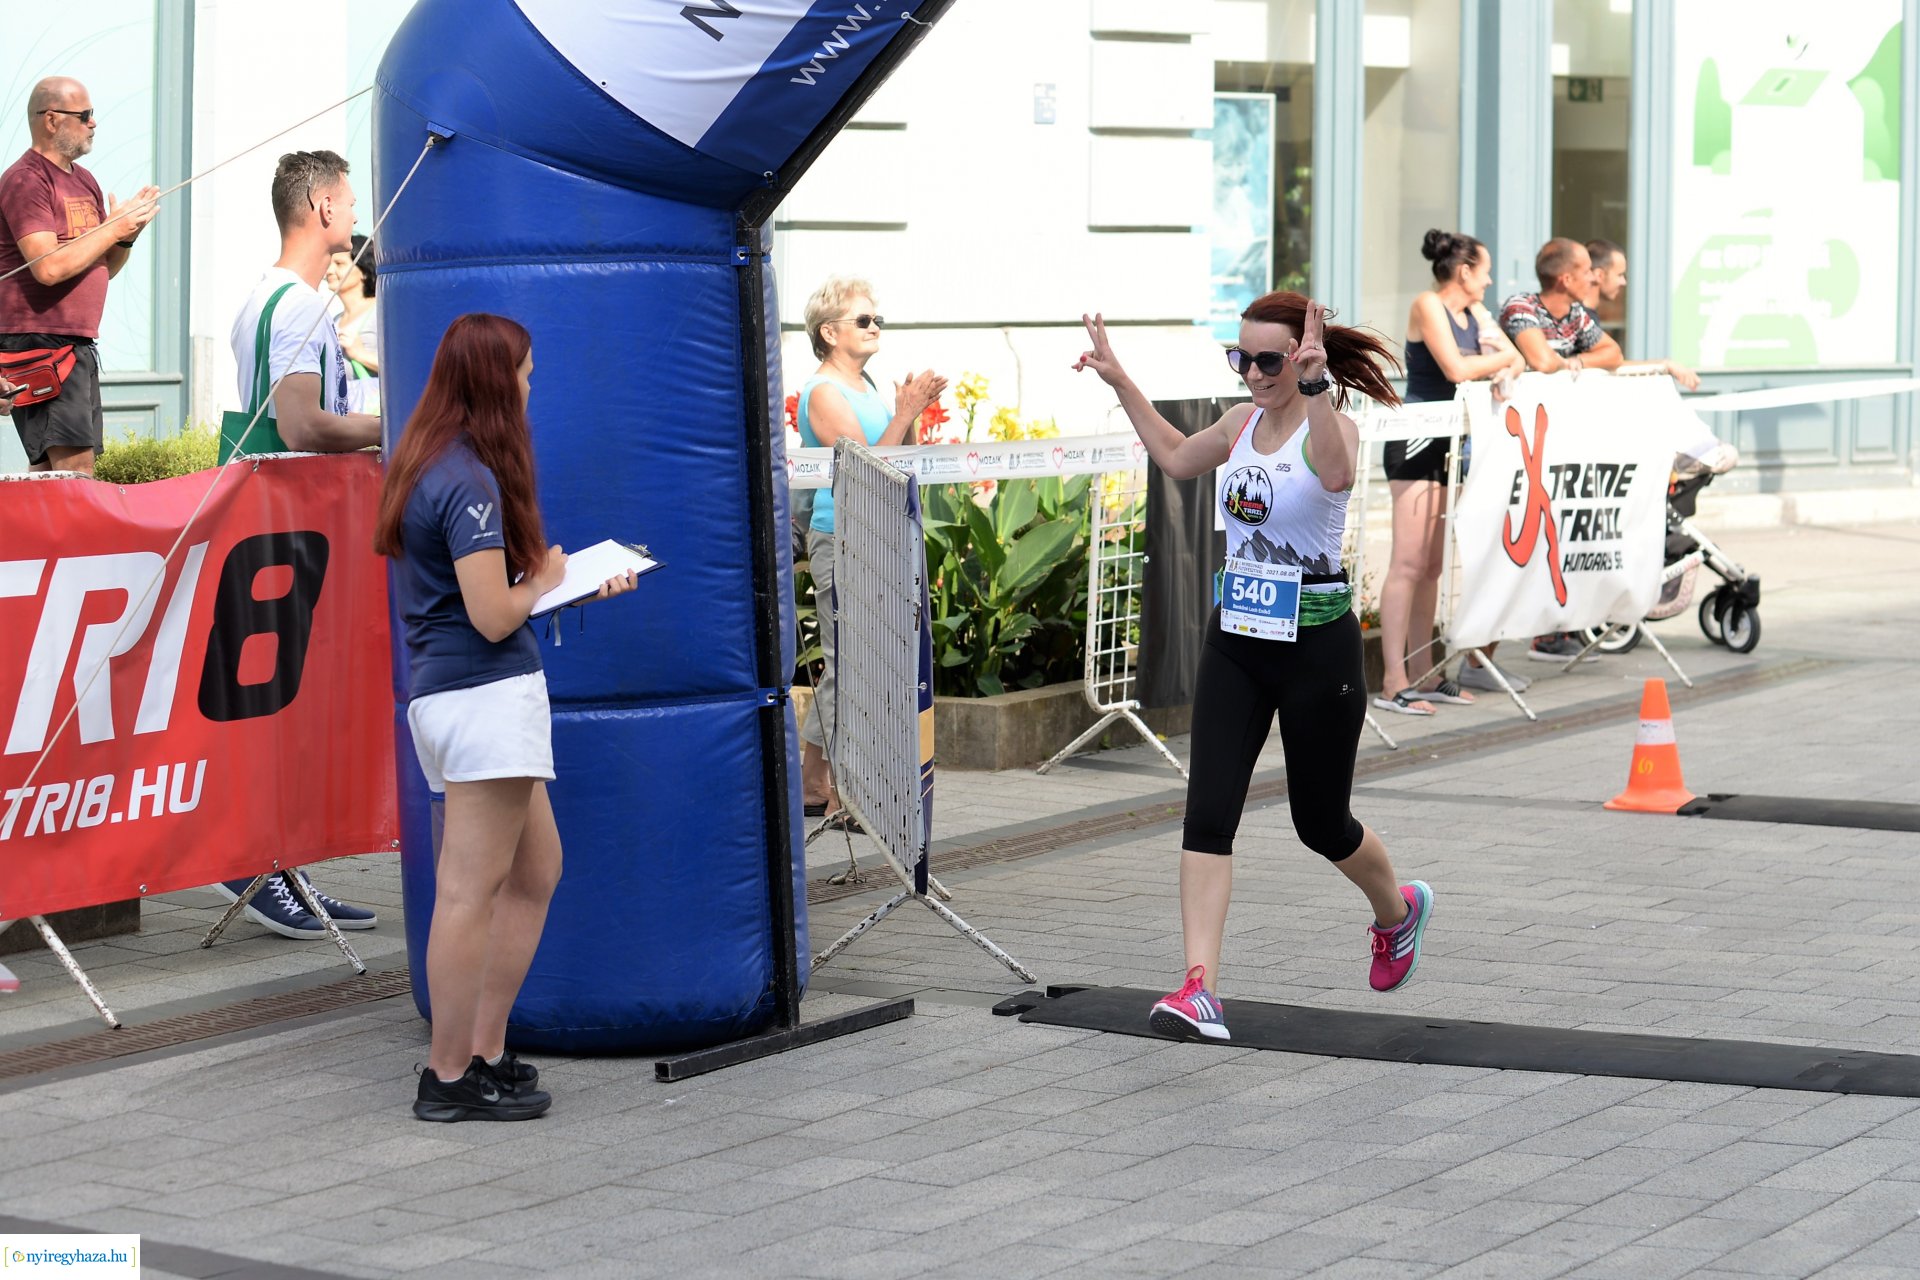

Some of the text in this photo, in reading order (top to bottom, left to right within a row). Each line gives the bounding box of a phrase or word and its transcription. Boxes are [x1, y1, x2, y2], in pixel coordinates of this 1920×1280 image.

[790, 0, 887, 86] www.
[794, 463, 821, 473] MOZAIK
[1559, 507, 1623, 543] TRAIL
[1231, 576, 1277, 607] 540
[0, 530, 330, 755] TRI8
[0, 759, 208, 841] TRI8.HU
